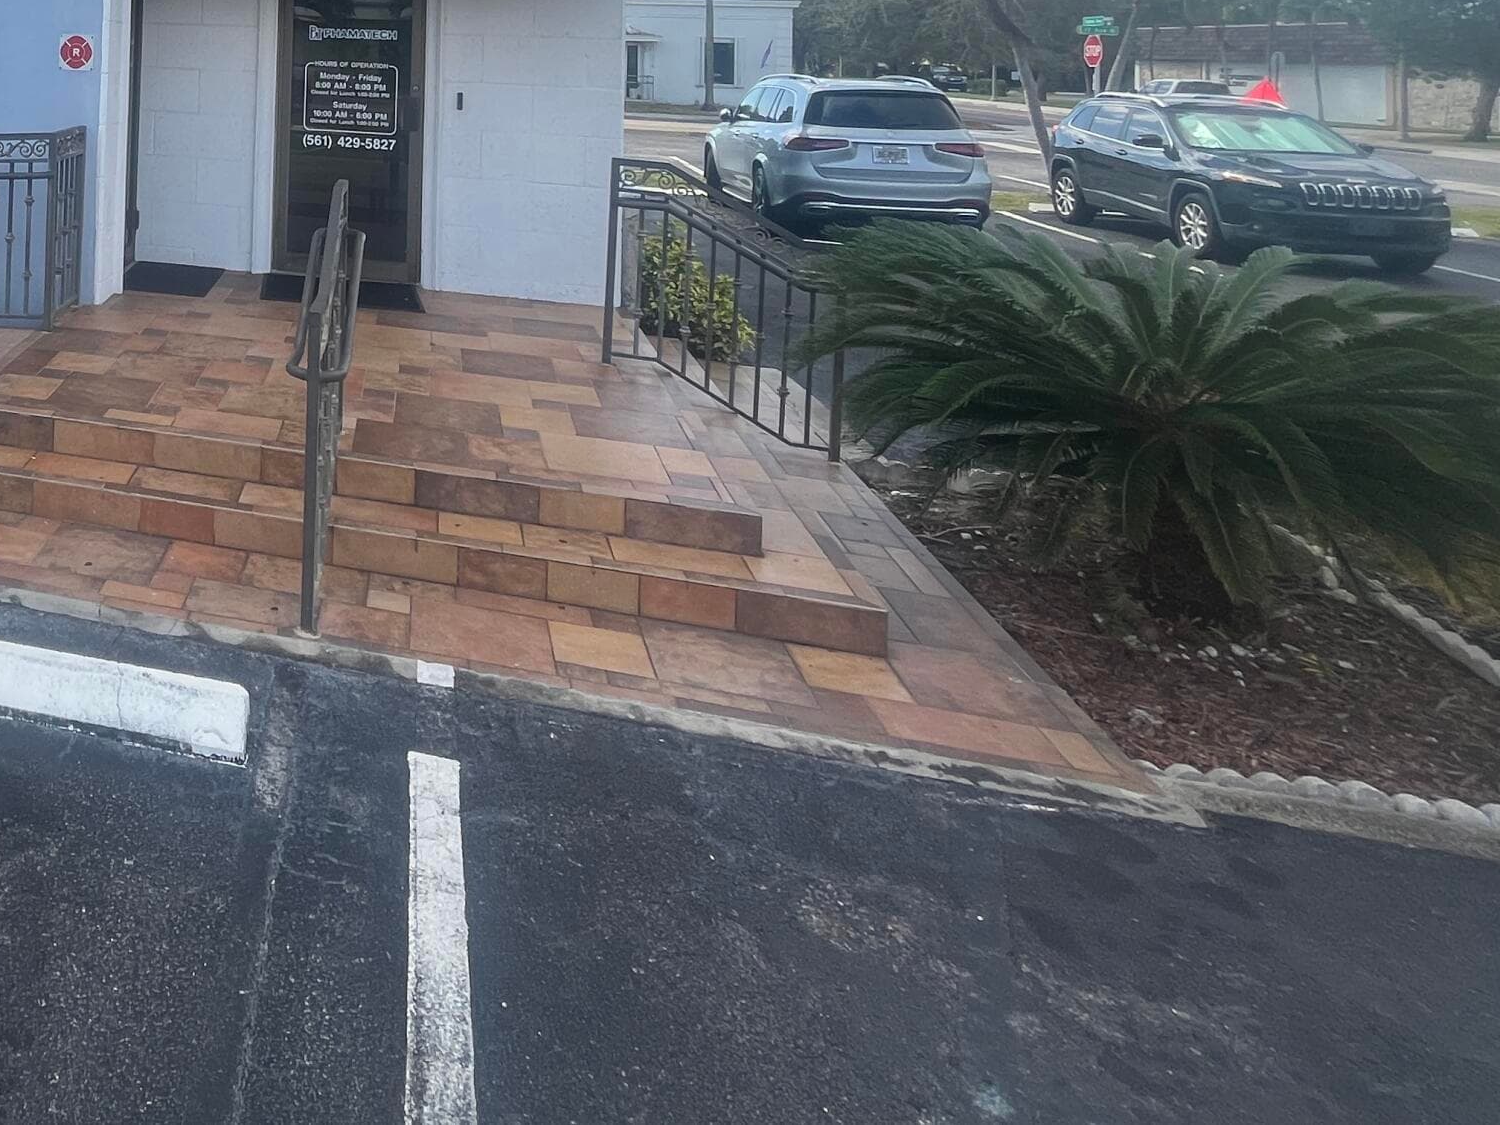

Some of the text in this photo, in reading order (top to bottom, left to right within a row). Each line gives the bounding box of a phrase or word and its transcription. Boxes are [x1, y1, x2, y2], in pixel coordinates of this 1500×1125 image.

[323, 28, 398, 40] PHAMATECH
[73, 48, 80, 57] R
[1085, 45, 1101, 56] STOP
[350, 62, 389, 70] OPERATION
[319, 72, 350, 82] Monday
[358, 74, 383, 83] Friday
[332, 101, 367, 112] Saturday
[334, 110, 348, 118] AM
[303, 133, 396, 150] (561) 429-5827
